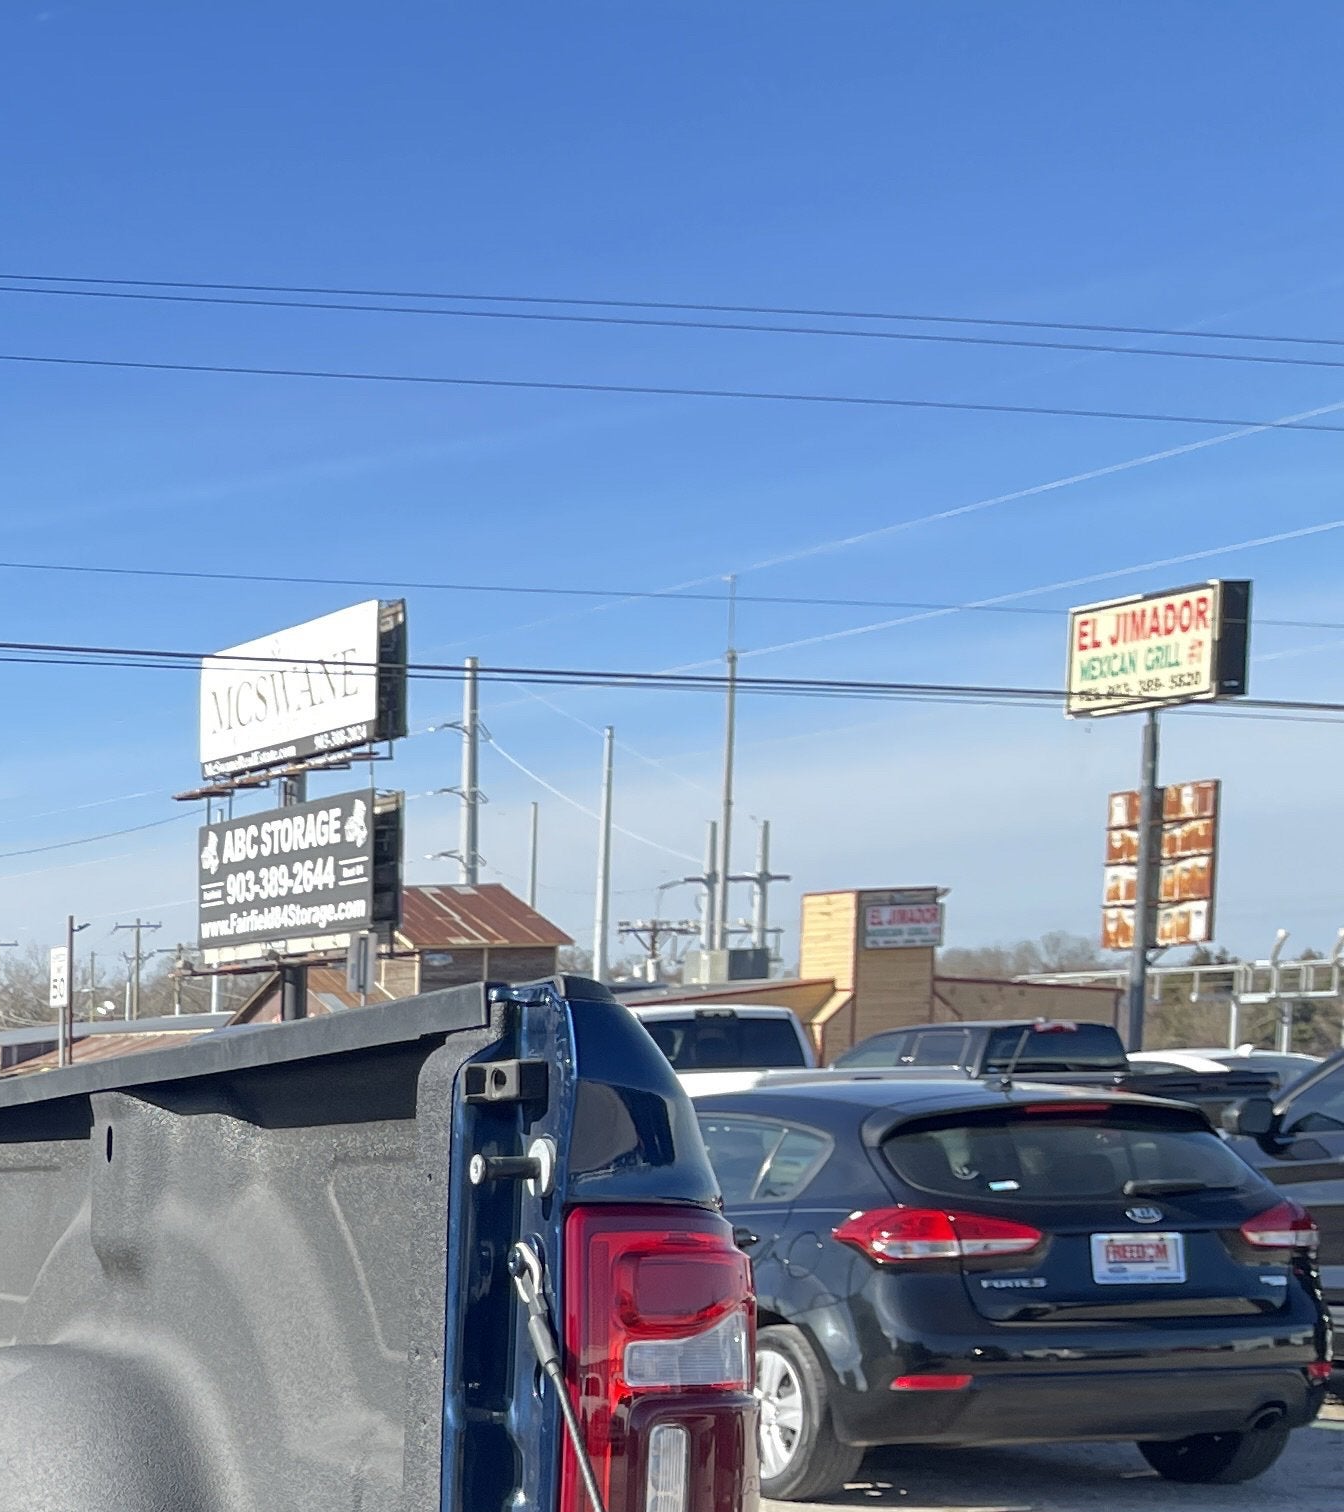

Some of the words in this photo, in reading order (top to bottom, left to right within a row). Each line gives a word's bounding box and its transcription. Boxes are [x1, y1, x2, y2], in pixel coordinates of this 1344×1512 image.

[1078, 618, 1101, 652] EL
[1109, 597, 1210, 646] JIMADOR
[1079, 650, 1138, 683] MEXICAN
[1144, 642, 1182, 671] GRILL
[222, 824, 259, 864] ABC
[260, 807, 342, 857] STORAGE
[226, 856, 336, 905] 903-389-2644
